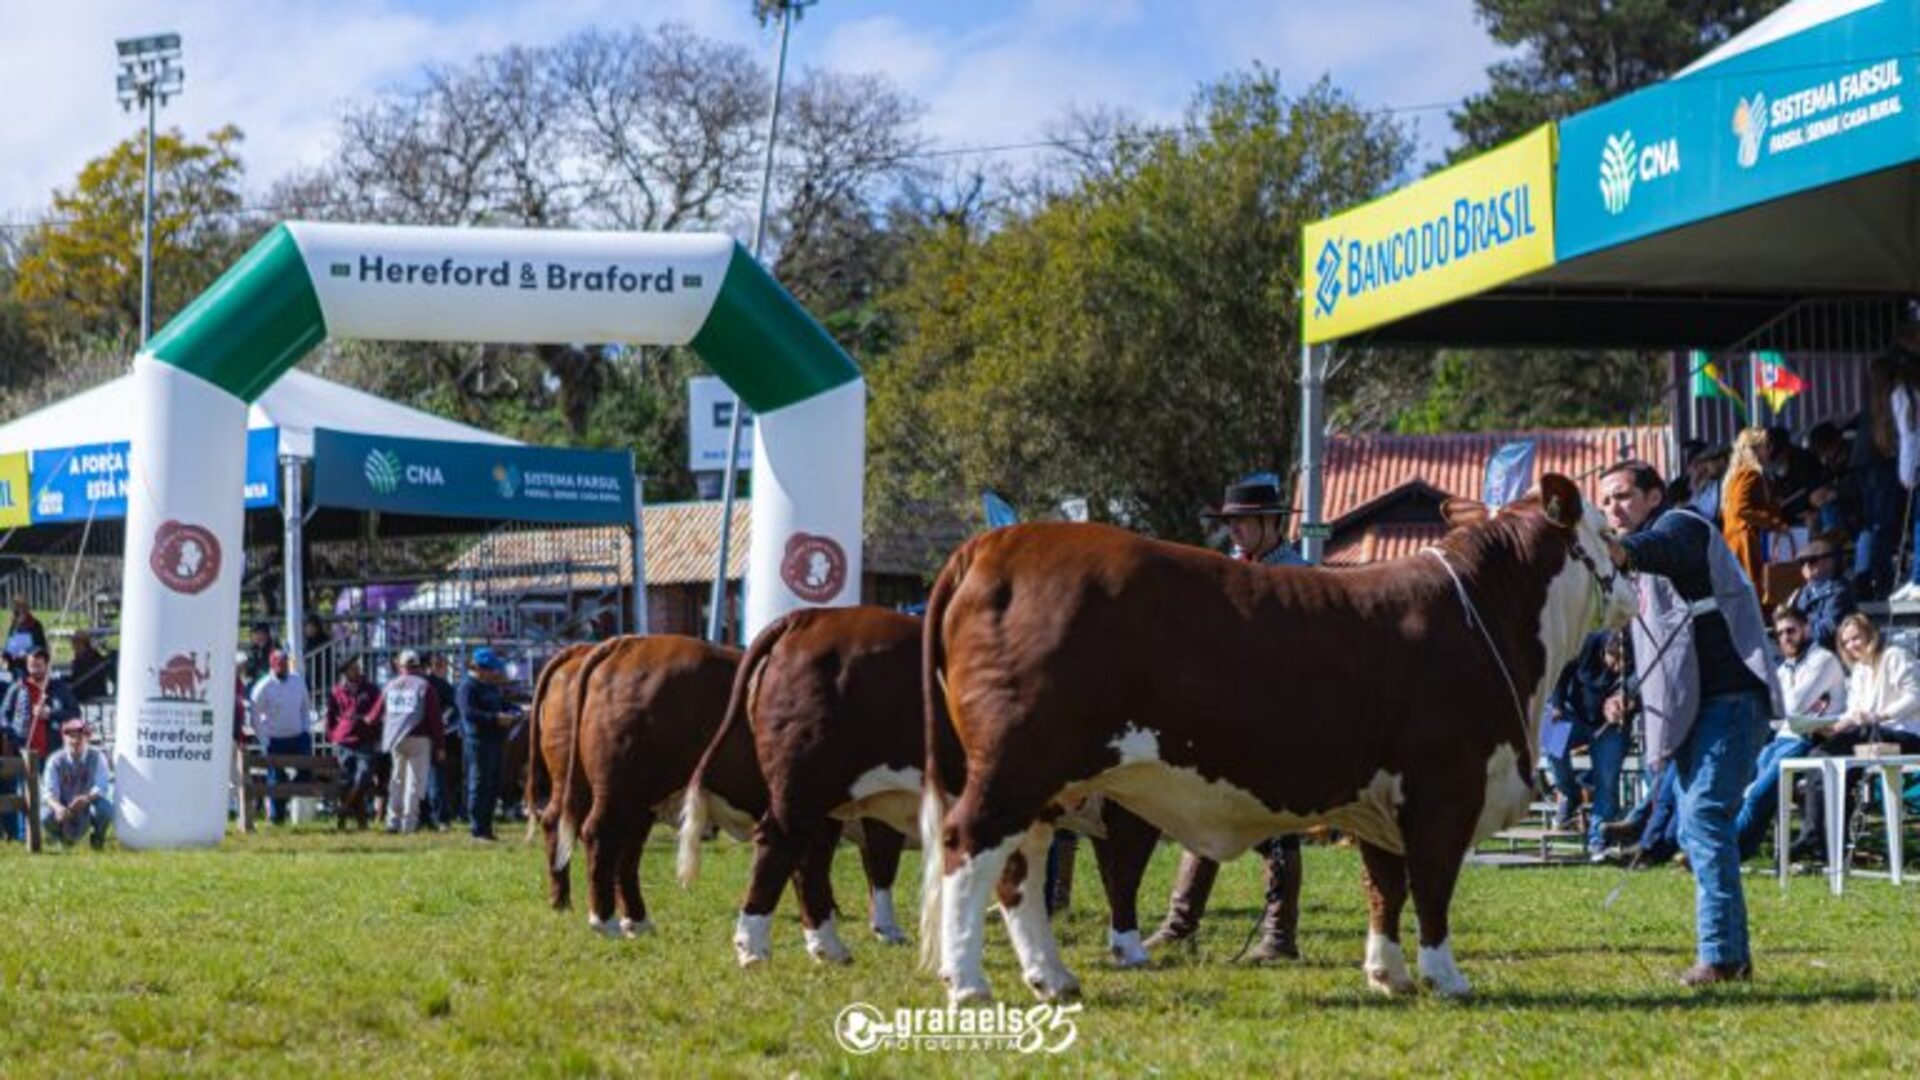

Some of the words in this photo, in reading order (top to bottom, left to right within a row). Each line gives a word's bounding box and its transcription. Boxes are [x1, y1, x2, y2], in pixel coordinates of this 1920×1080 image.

[1770, 80, 1837, 128] SISTEMA
[1839, 58, 1902, 105] FARSUL
[1640, 137, 1680, 181] CNA
[1347, 226, 1418, 297] BANCO
[1421, 216, 1449, 271] DO
[1454, 184, 1536, 259] BRASIL
[359, 255, 510, 287] Hereford
[519, 262, 538, 289] &
[546, 264, 674, 293] Braford
[405, 464, 444, 486] CNA
[524, 471, 576, 488] SISTEMA
[577, 473, 620, 491] FARSUL
[137, 727, 213, 743] Hereford
